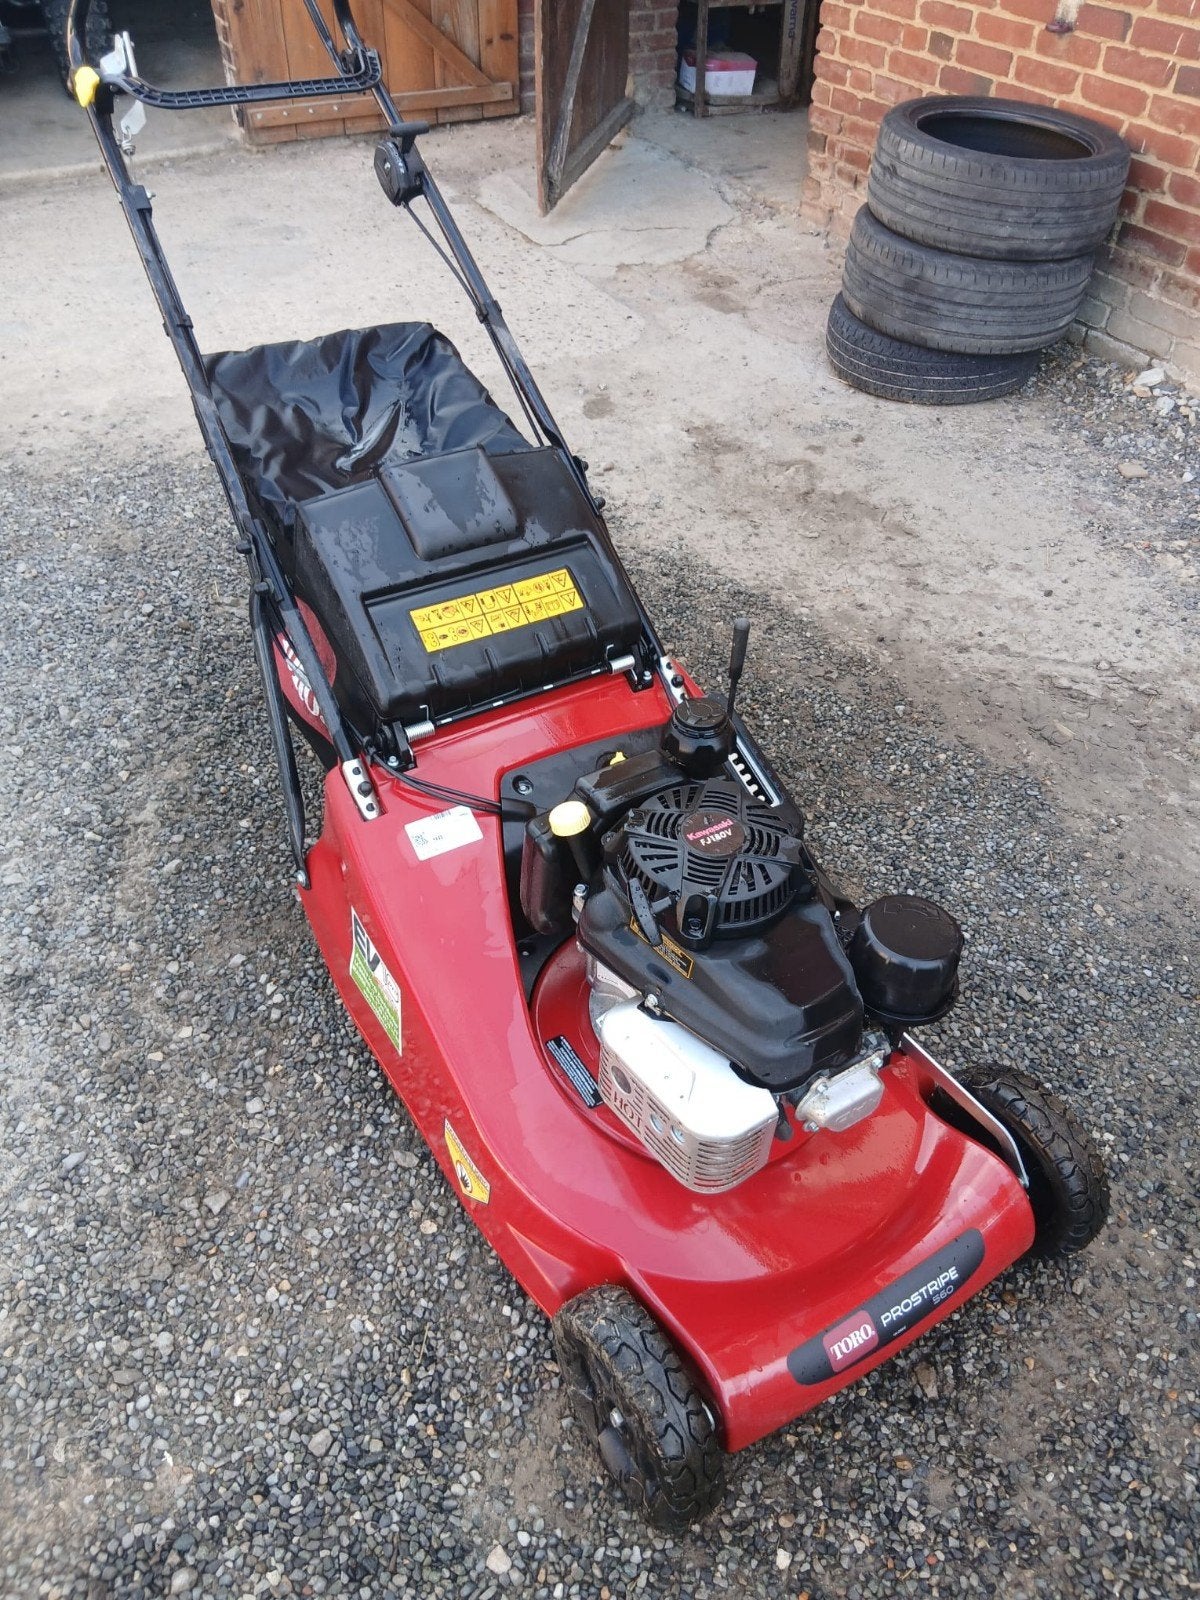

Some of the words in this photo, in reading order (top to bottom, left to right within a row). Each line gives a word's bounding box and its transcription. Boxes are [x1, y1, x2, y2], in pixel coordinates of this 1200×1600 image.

[686, 818, 734, 841] Kawasaki
[699, 828, 732, 847] FJ180V
[614, 1091, 641, 1128] HOT
[880, 1265, 959, 1327] PROSTRIPE
[830, 1323, 873, 1361] TORO
